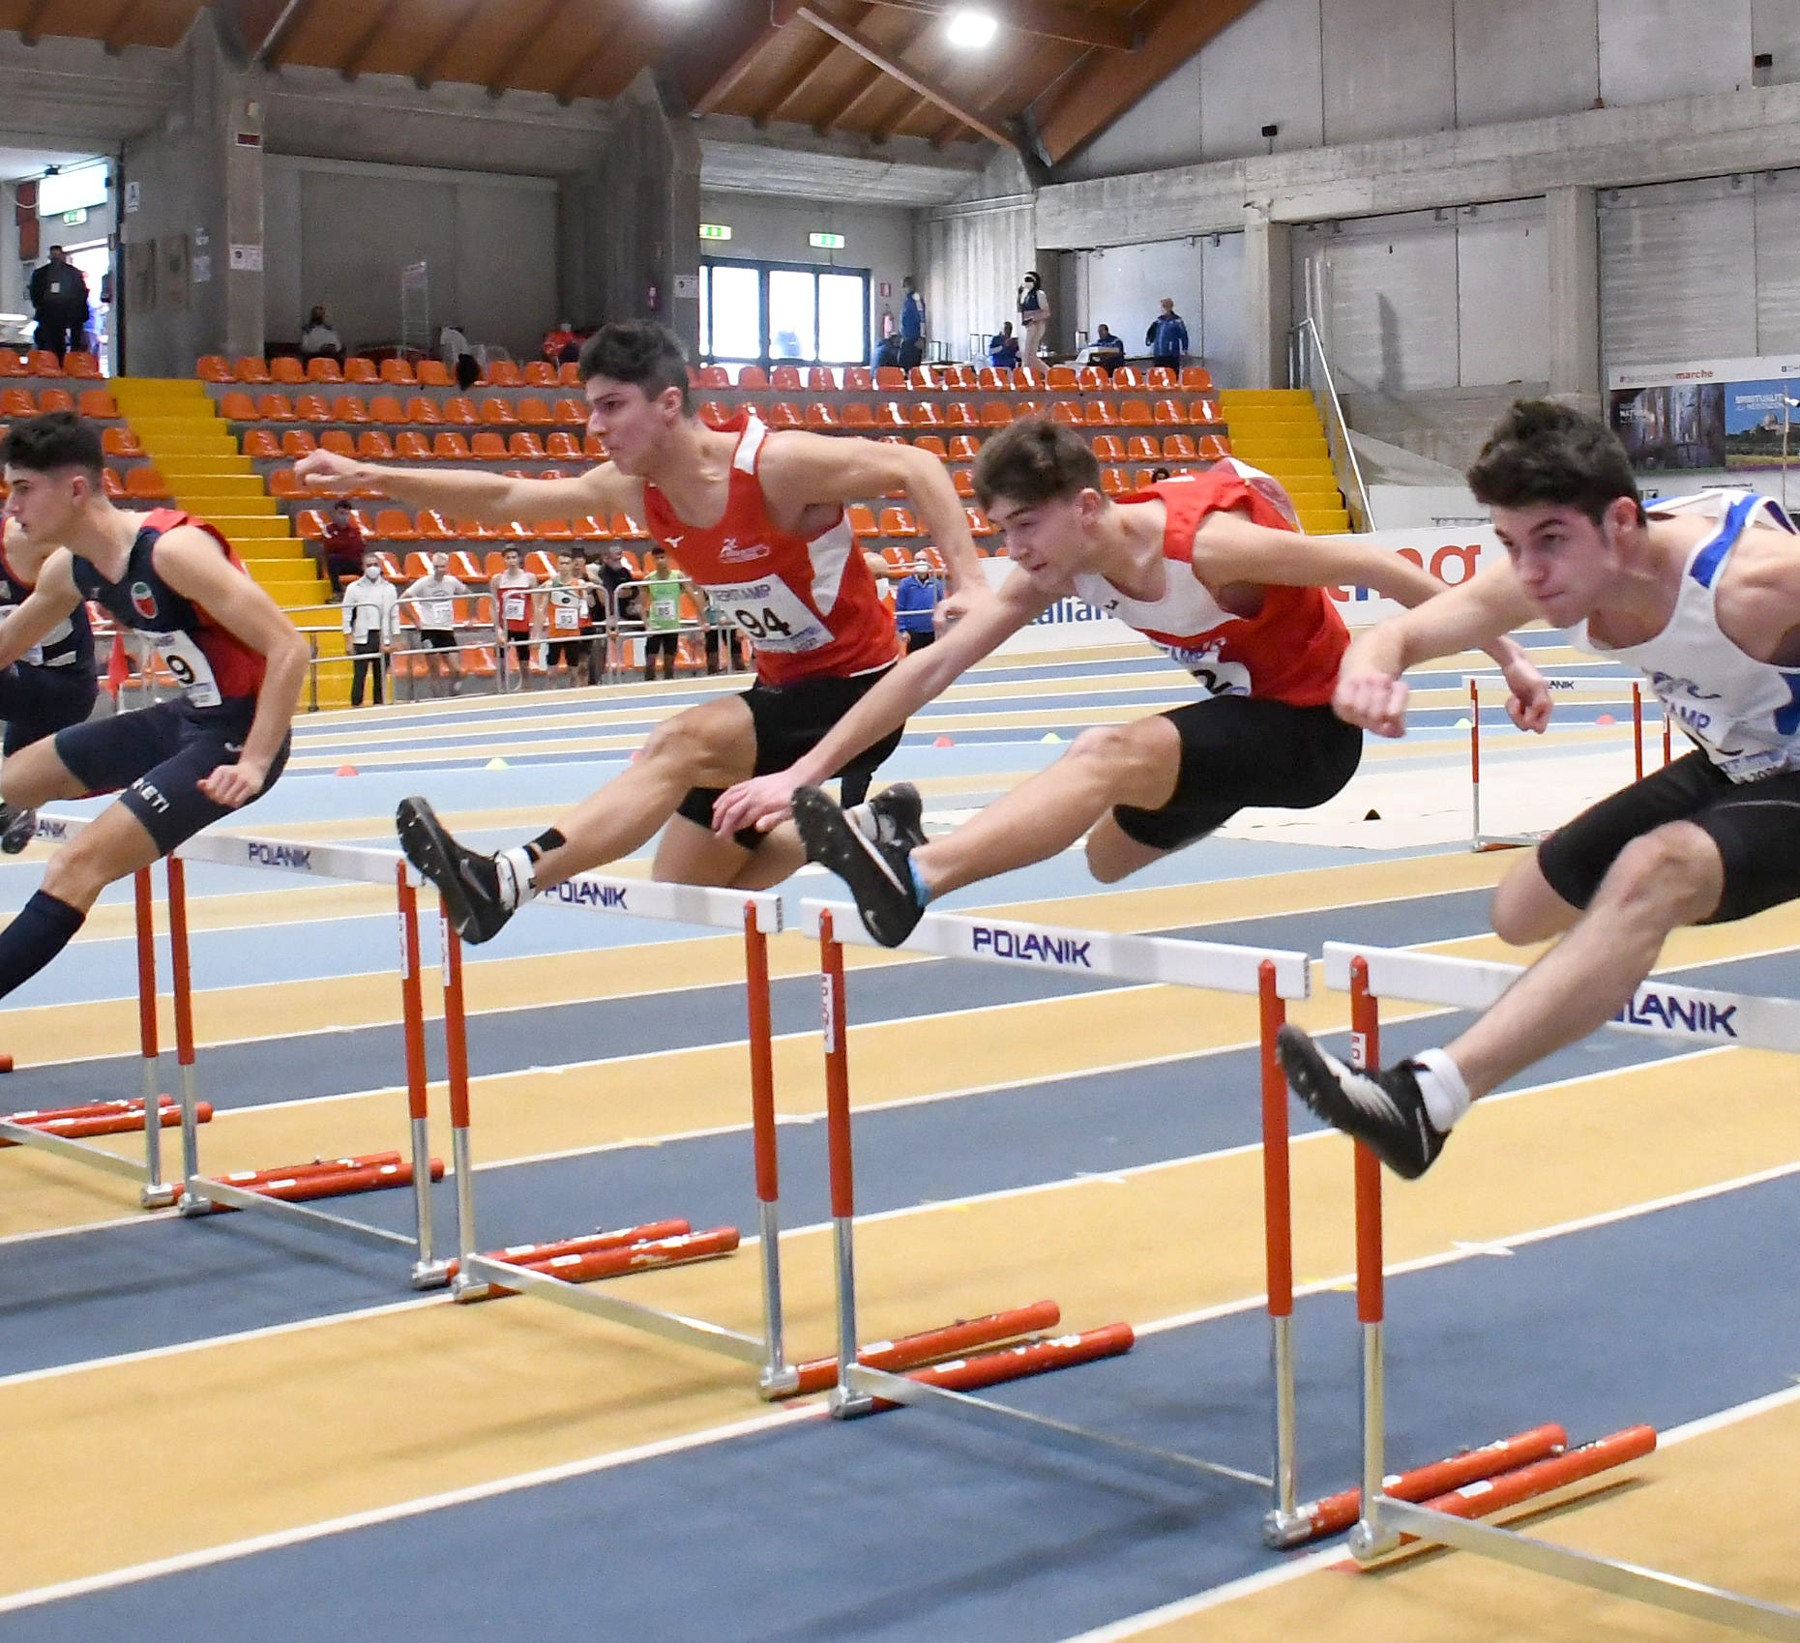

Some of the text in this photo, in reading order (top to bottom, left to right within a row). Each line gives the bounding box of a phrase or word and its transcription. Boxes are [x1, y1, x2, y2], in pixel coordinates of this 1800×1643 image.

[735, 607, 792, 639] 94
[166, 654, 196, 685] 9
[247, 842, 312, 870] POLANIK
[972, 926, 1092, 968] POLANIK
[1614, 992, 1738, 1039] LANIK
